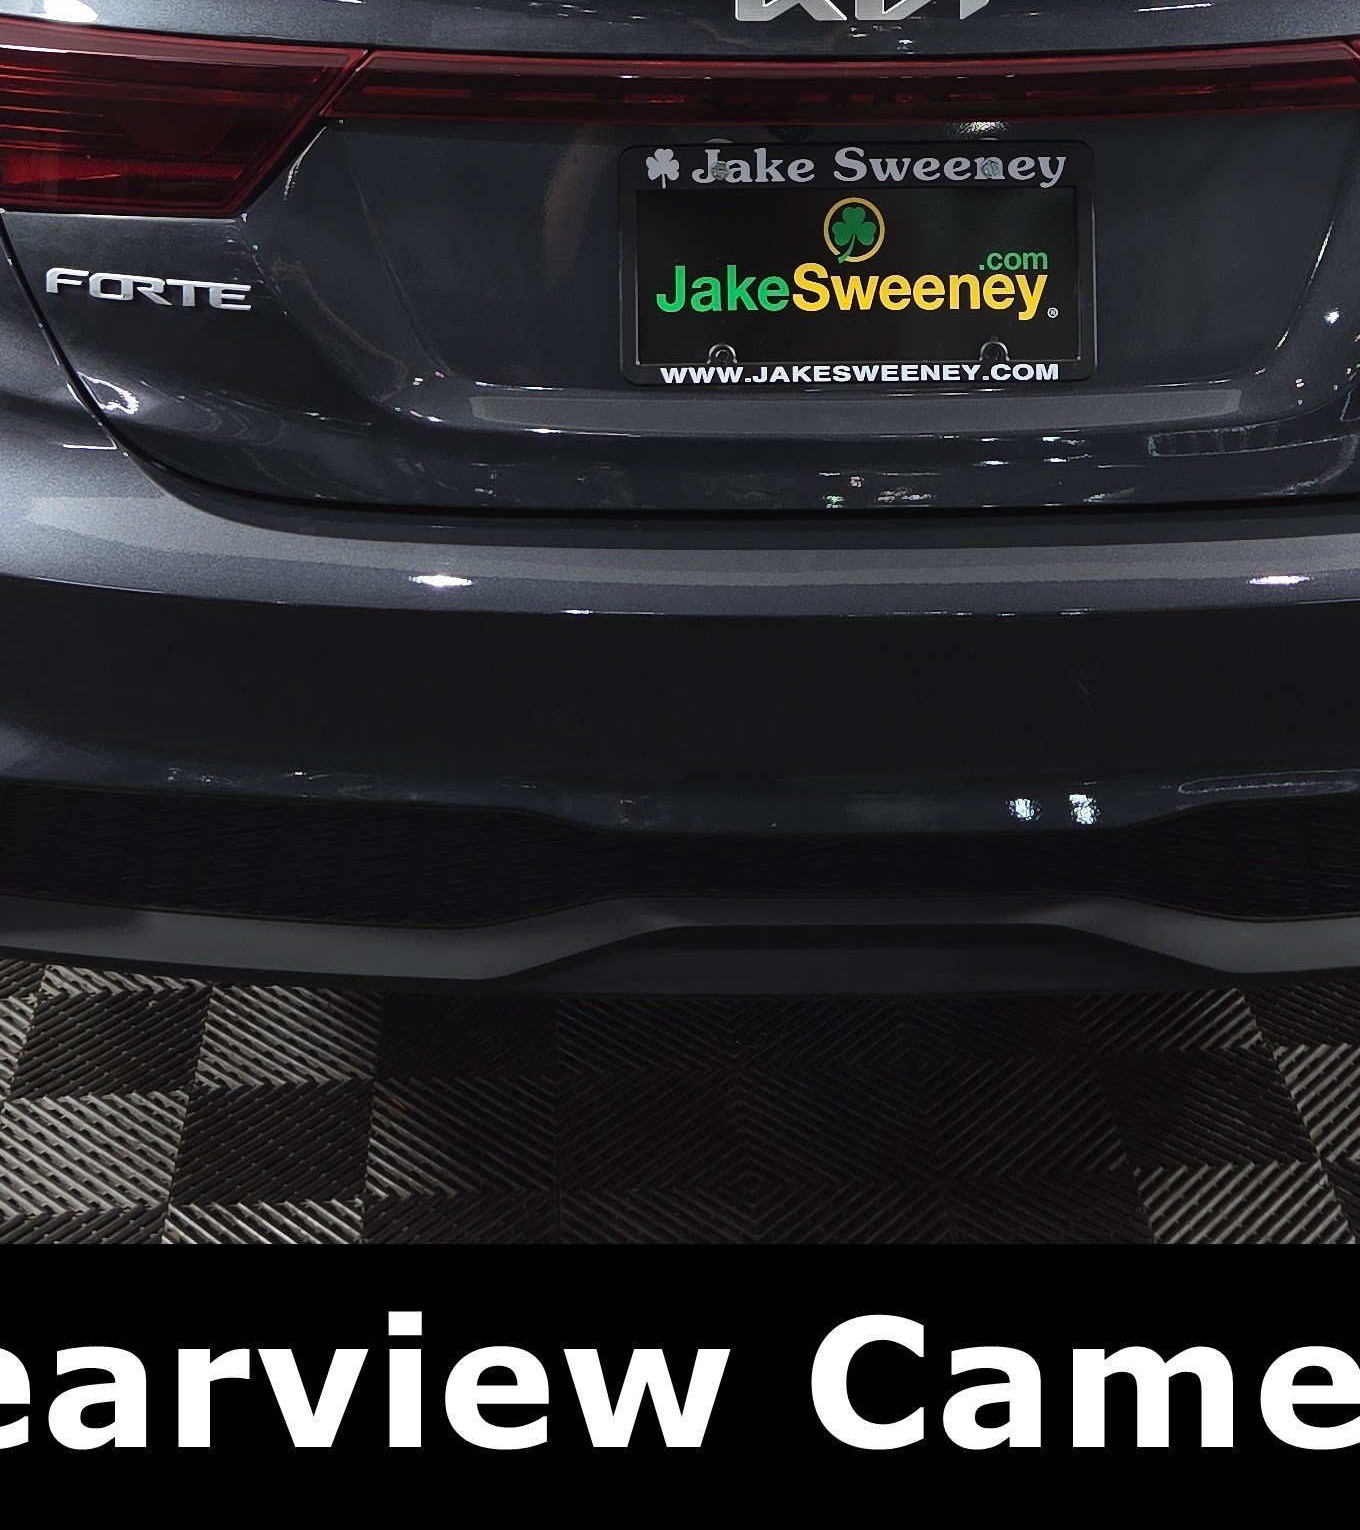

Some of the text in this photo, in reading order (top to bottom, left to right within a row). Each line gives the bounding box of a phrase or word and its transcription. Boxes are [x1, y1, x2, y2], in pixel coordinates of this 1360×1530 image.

[691, 146, 1067, 189] Jake Sweeney
[978, 249, 1049, 271] .com
[45, 266, 252, 311] FORTE
[659, 363, 1060, 384] WWW.JAKESWEENEY.COM
